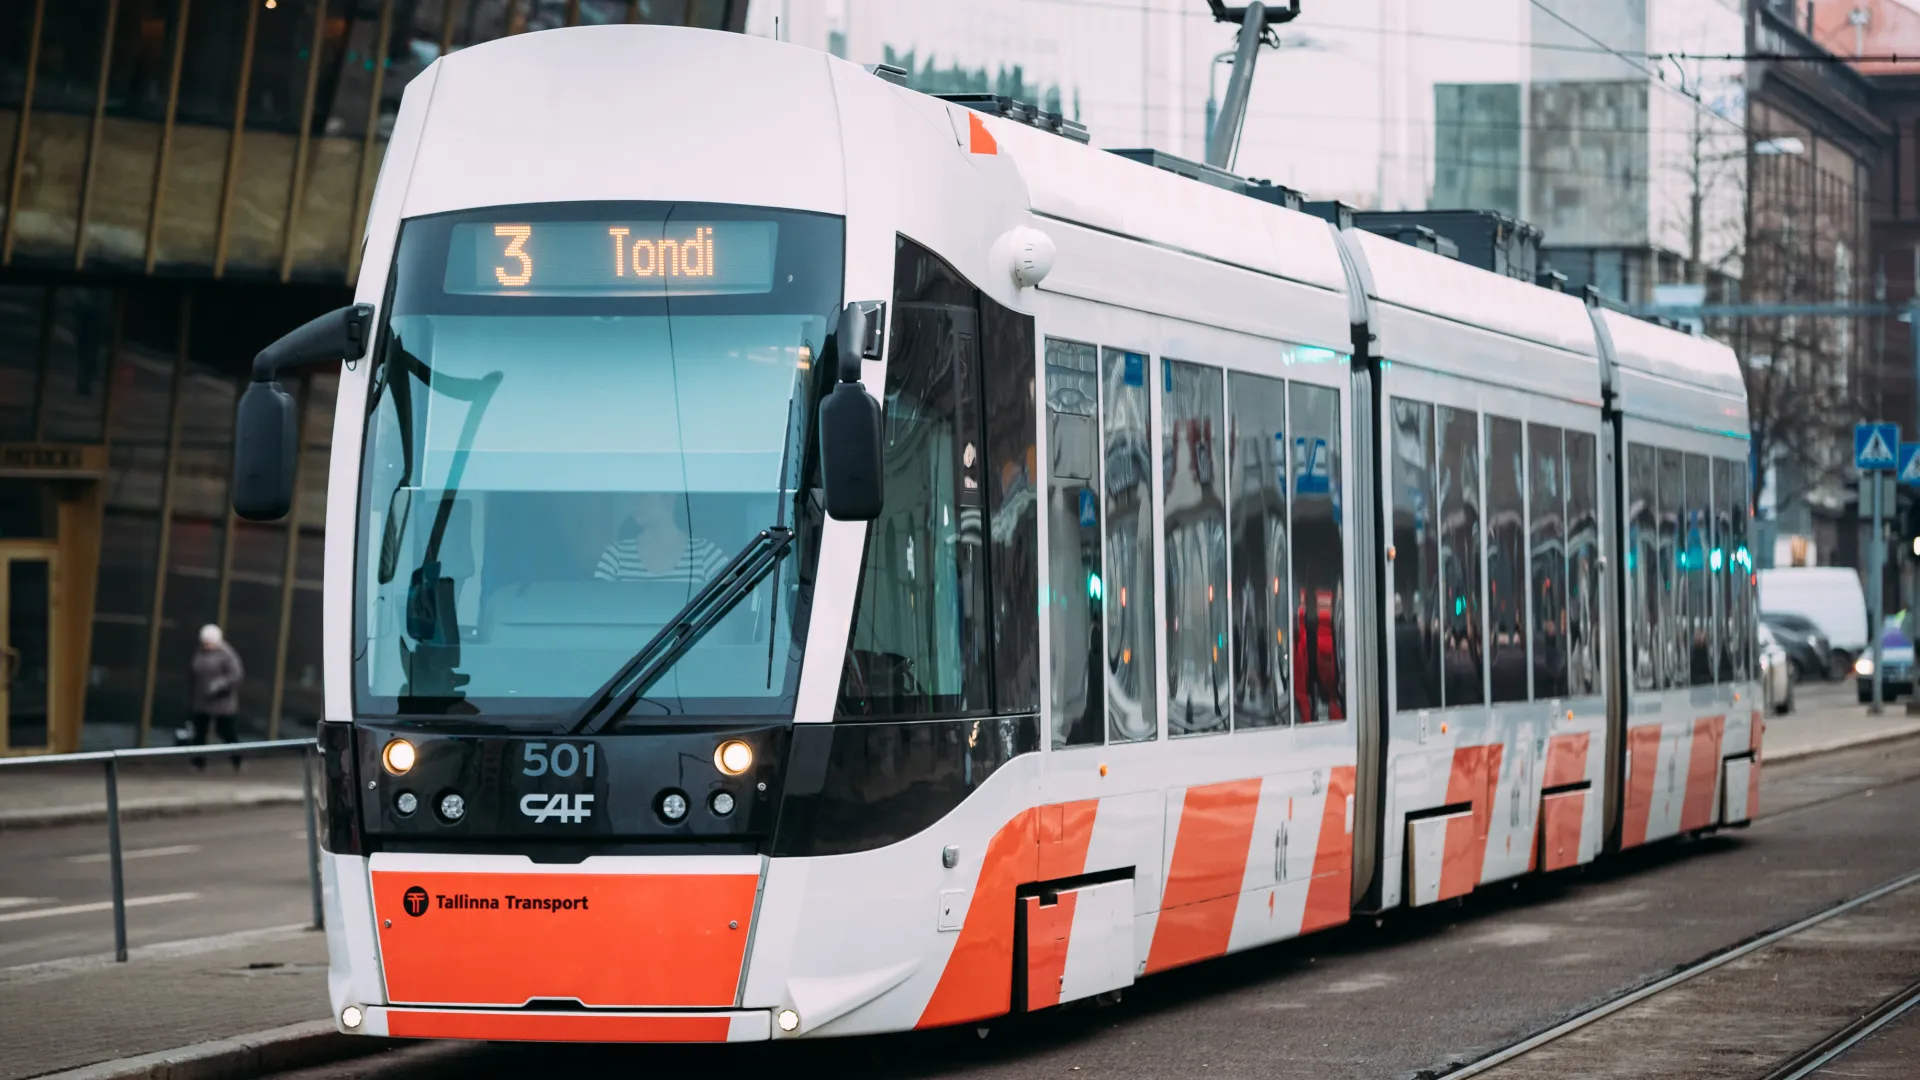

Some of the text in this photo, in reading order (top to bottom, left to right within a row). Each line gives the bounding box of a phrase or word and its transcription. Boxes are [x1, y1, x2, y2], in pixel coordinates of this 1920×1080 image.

[495, 224, 714, 287] 3 Tondi
[523, 743, 594, 777] 501
[519, 793, 594, 823] CAF
[436, 894, 499, 909] Tallinna
[505, 895, 589, 913] Transport
